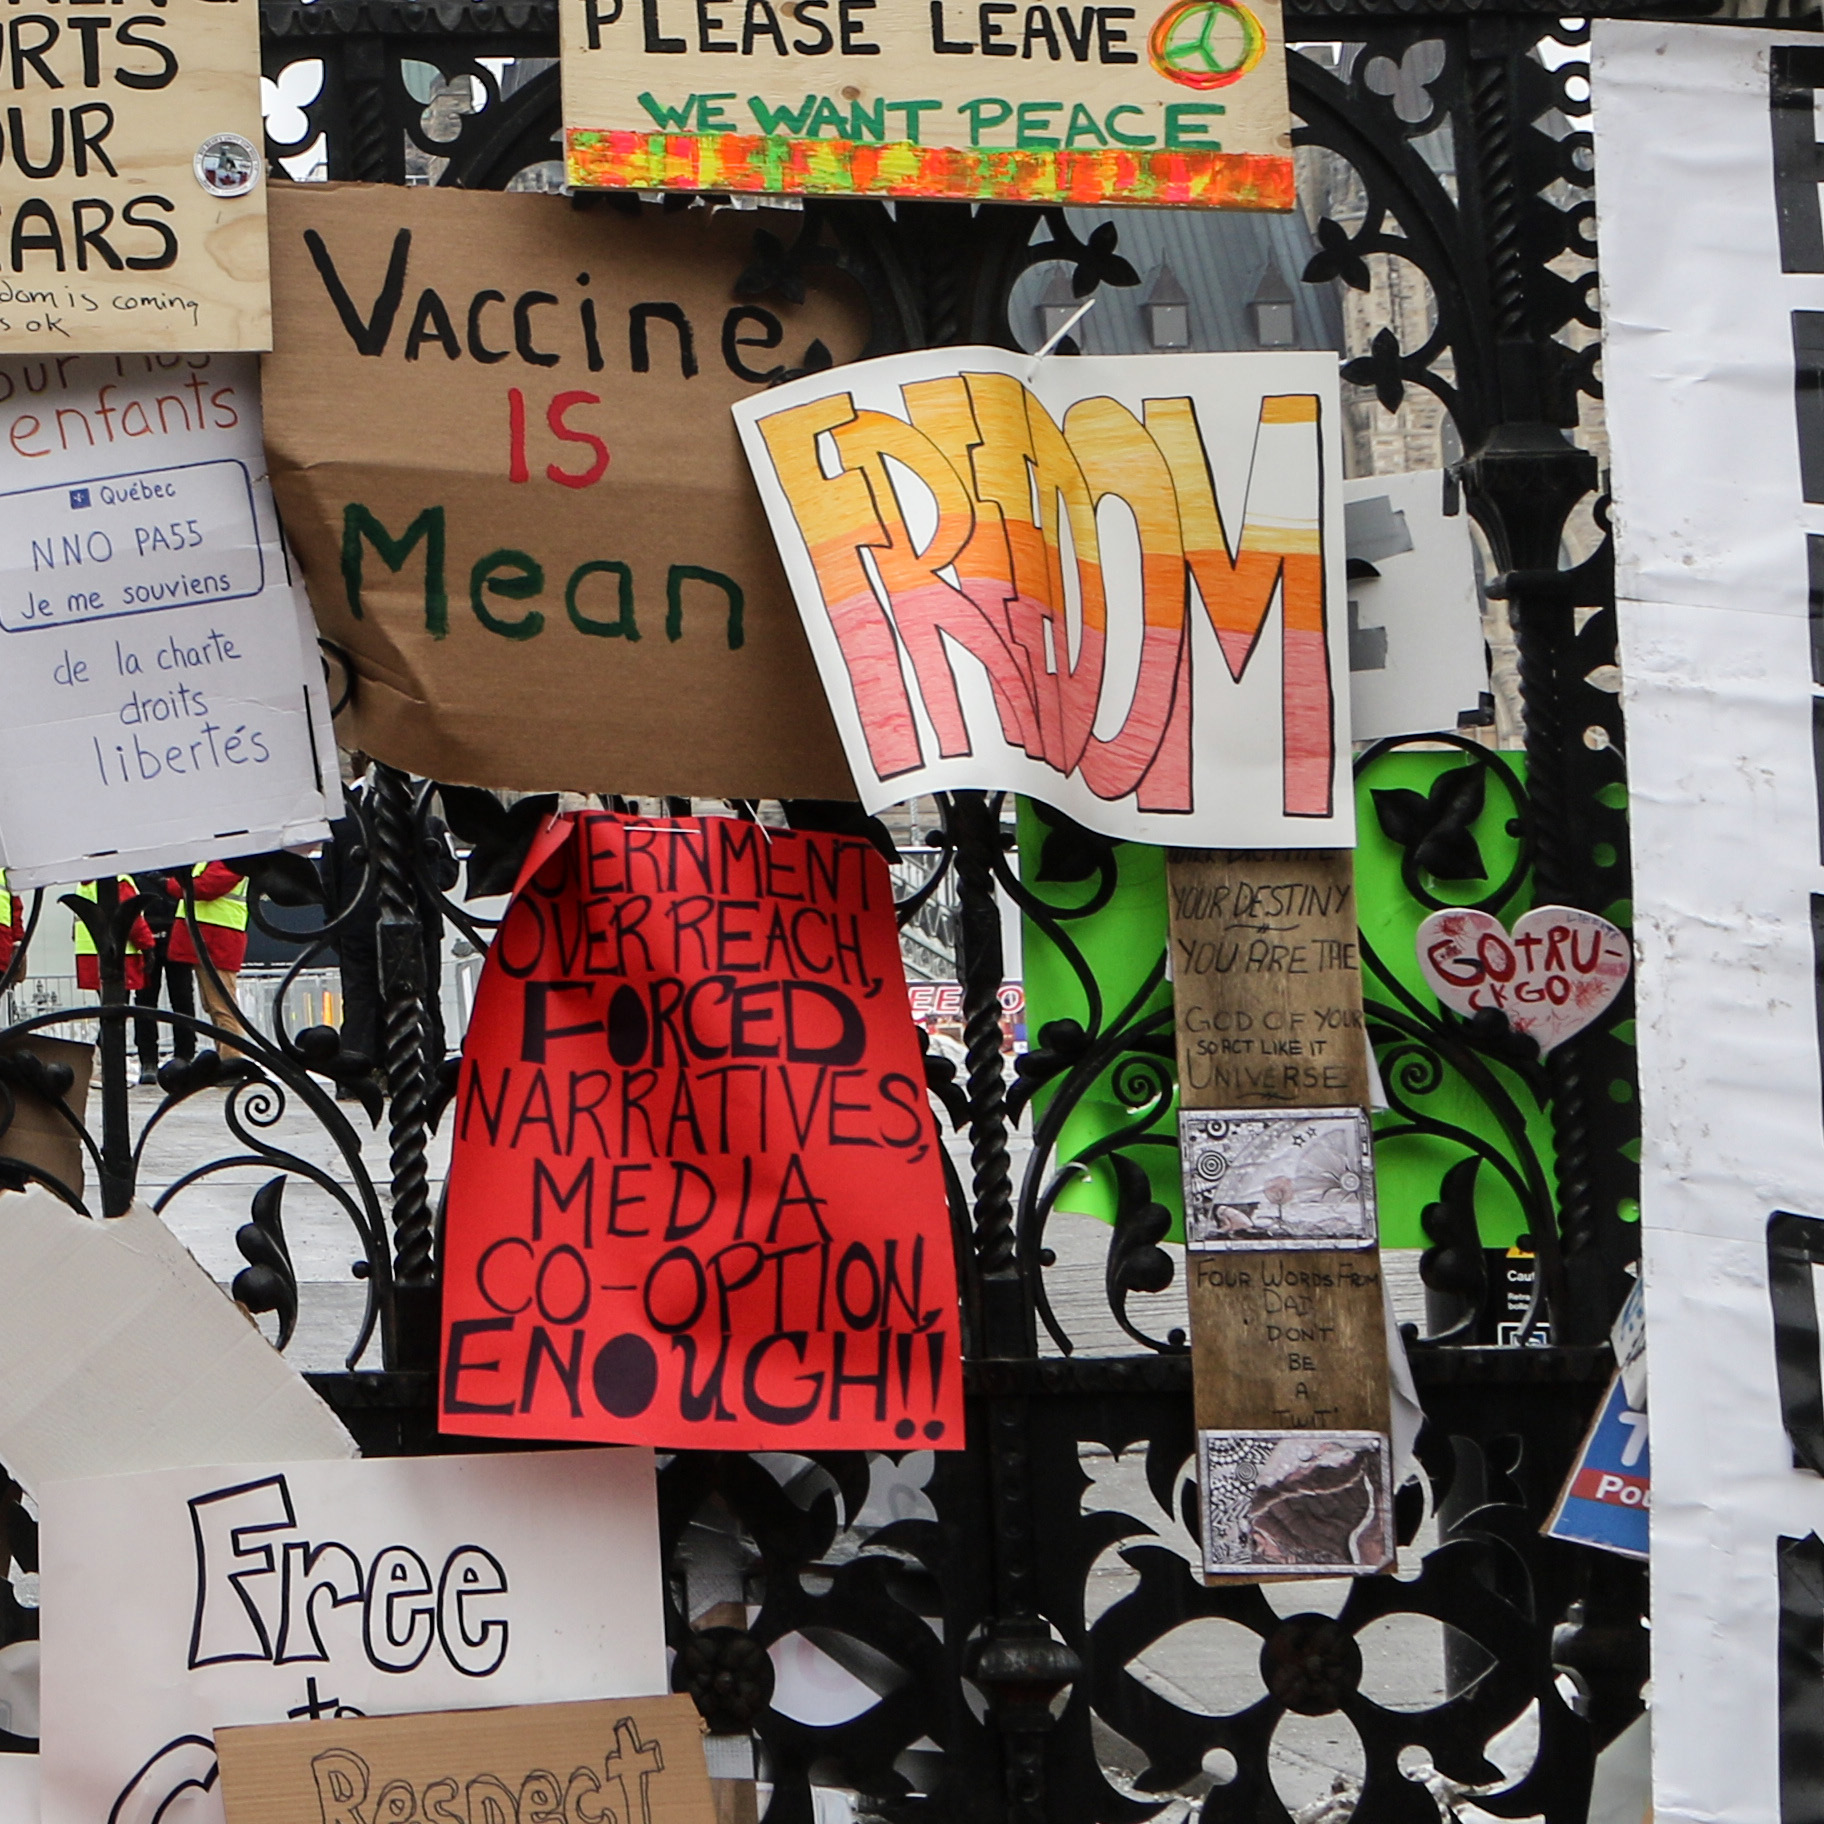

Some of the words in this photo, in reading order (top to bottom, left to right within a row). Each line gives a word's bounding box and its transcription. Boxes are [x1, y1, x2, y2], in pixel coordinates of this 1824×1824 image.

[929, 0, 1139, 65] LEAVE
[631, 91, 746, 142] WE
[740, 86, 950, 153] WANT
[957, 97, 1234, 158] PEACE
[64, 285, 99, 312] is
[111, 295, 199, 327] coming
[302, 220, 797, 390] Vaccine
[8, 374, 240, 460] enfants
[500, 387, 611, 497] IS
[99, 479, 177, 505] Québec
[31, 530, 113, 573] NNO
[21, 591, 54, 620] Je
[67, 592, 105, 612] me
[122, 574, 231, 605] souviens
[333, 502, 754, 660] Mean
[53, 649, 90, 687] de
[115, 640, 144, 676] la
[157, 628, 242, 670] charte
[119, 682, 209, 726] droits
[93, 721, 270, 786] libertés
[1171, 884, 1229, 920] YOUR
[1233, 882, 1351, 918] DESTINY
[1178, 939, 1239, 975] YOU
[1245, 939, 1309, 974] ARE
[1312, 939, 1359, 971] THE
[1427, 932, 1517, 988] GO
[520, 976, 867, 1069] FORCED
[1185, 1006, 1253, 1032] GOD
[1263, 1011, 1306, 1031] OF
[1261, 1039, 1302, 1056] LIKE
[1309, 1040, 1328, 1056] IT
[1187, 1048, 1348, 1090] UNIVERSE
[461, 1059, 931, 1163] NARRATIVES,
[531, 1153, 833, 1250] MEDIA
[476, 1233, 945, 1335] CO-OPTION,
[1197, 1257, 1251, 1288] FOUR
[1262, 1260, 1334, 1287] WORDS
[1288, 1353, 1316, 1371] BE
[186, 1473, 509, 1678] Free
